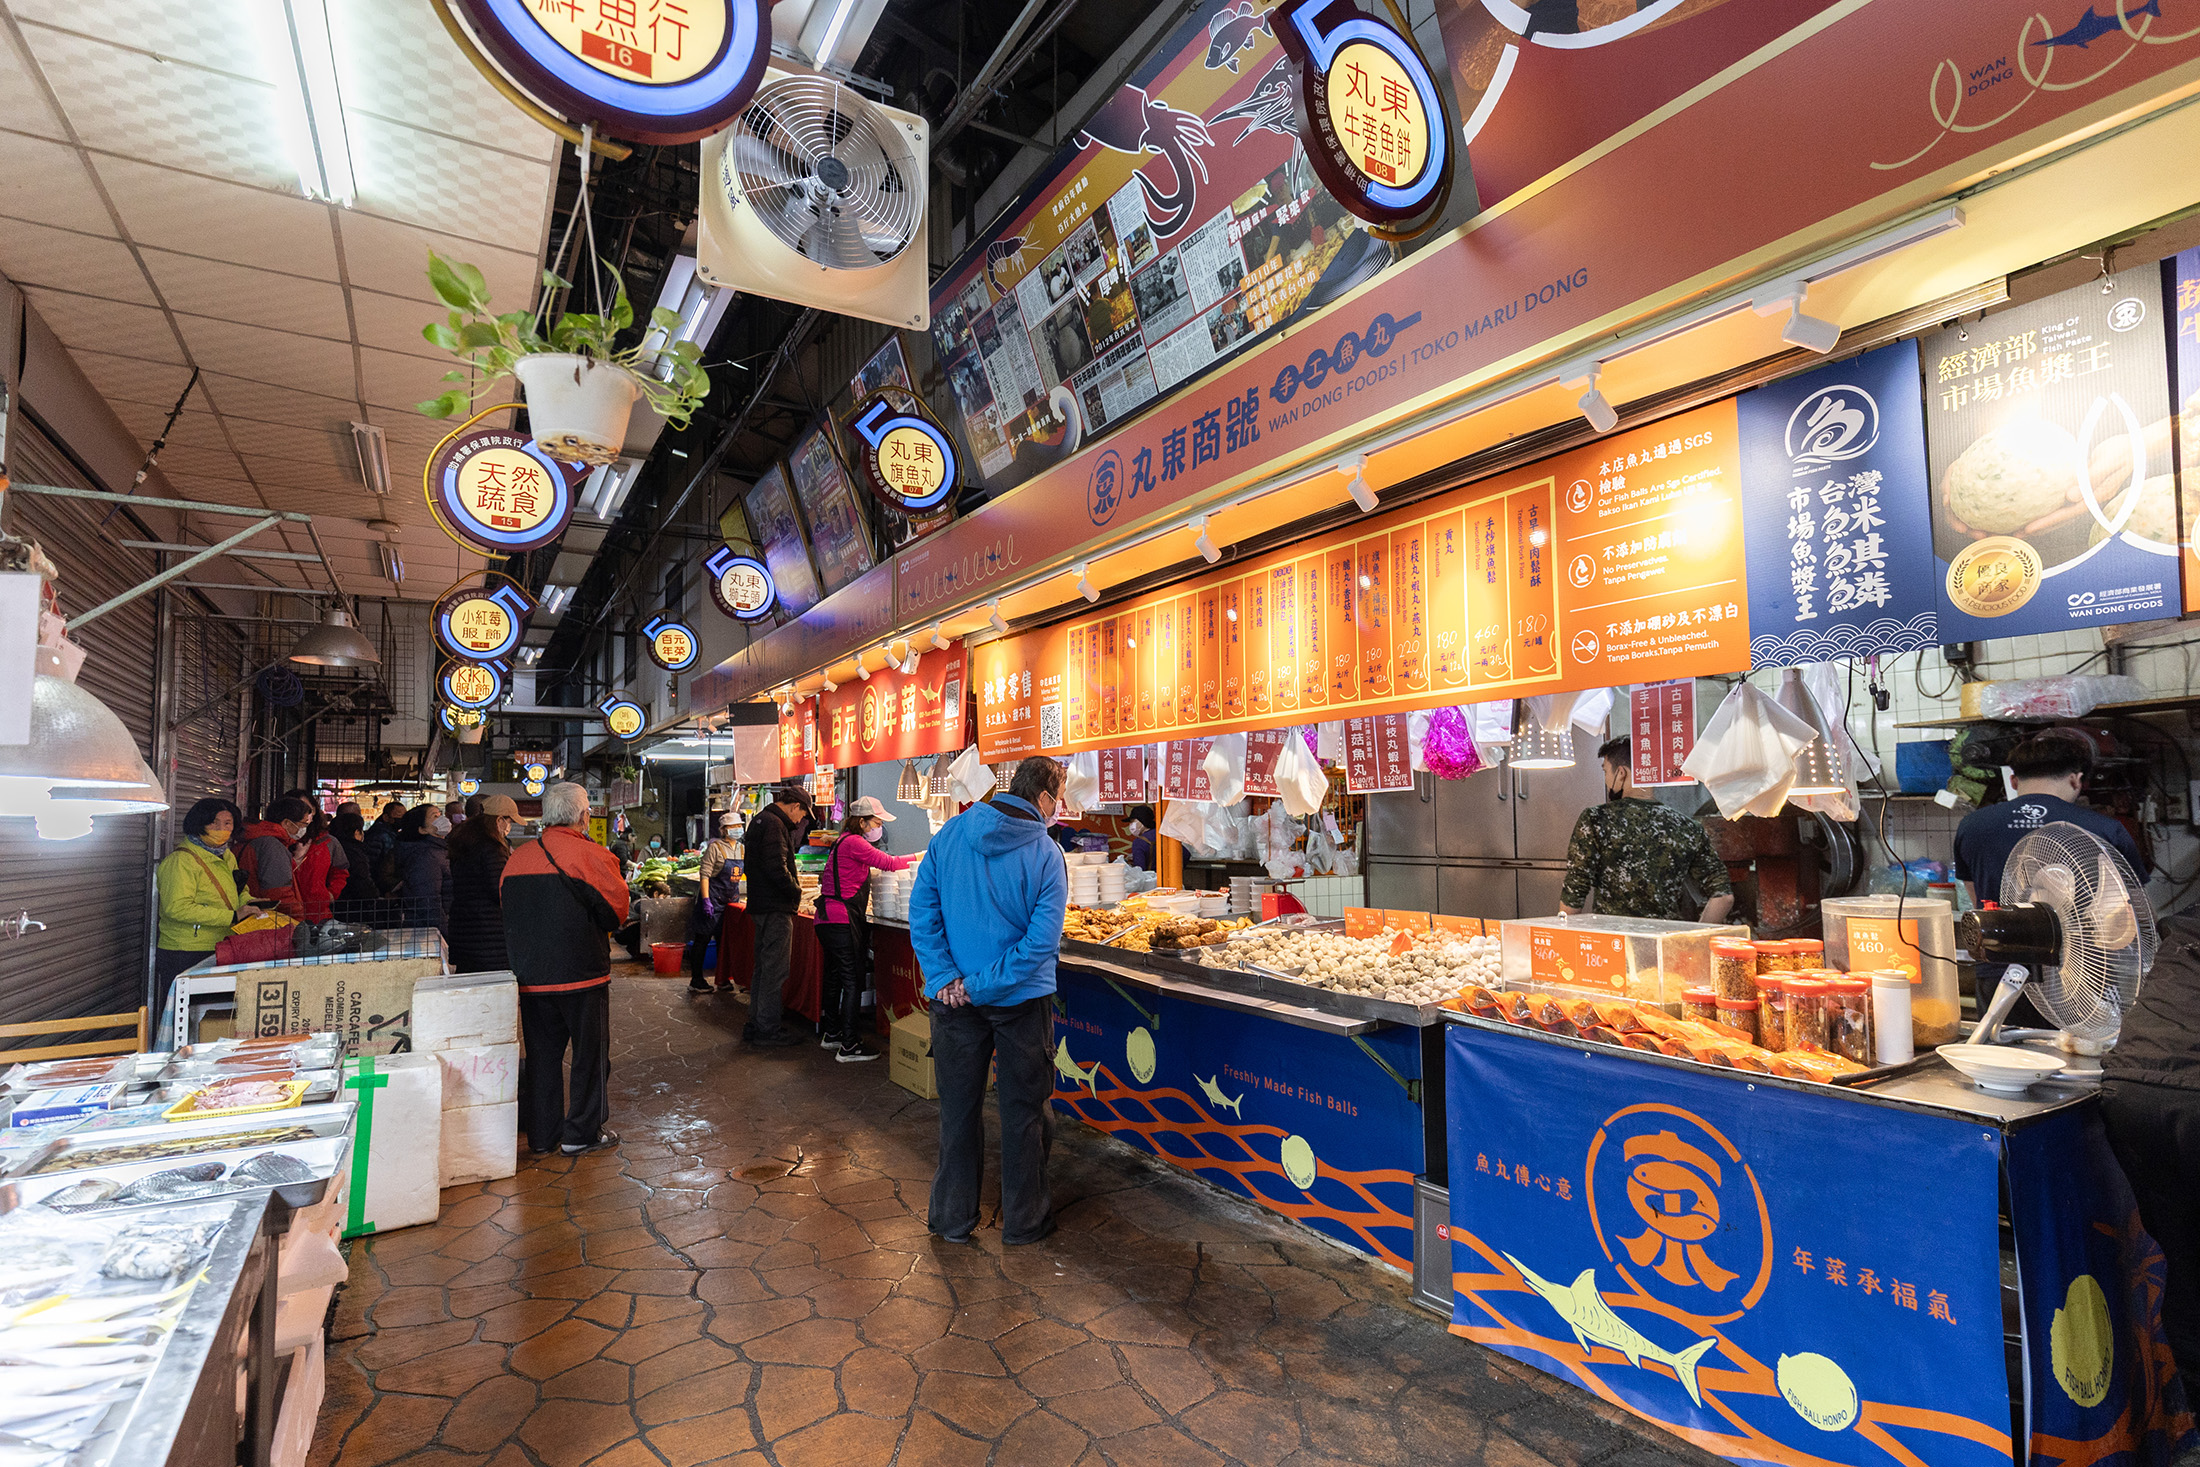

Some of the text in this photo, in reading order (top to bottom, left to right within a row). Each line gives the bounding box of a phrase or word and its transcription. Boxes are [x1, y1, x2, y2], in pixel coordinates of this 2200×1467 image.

[606, 43, 633, 67] 16
[1970, 57, 2007, 81] WAN
[1345, 62, 1411, 124] 丸東
[1968, 68, 2014, 97] DONG
[1344, 106, 1411, 170] 牛蒡魚餅
[1375, 163, 1388, 177] 08
[1244, 258, 1279, 288] 2010年
[2042, 316, 2079, 334] King Of
[2042, 329, 2077, 344] Taiwan
[1268, 267, 1588, 433] WAN DONG FOODS TOKO MARU DONG
[1938, 329, 2037, 384] 經濟部
[2043, 335, 2092, 354] Fish Paste
[1279, 323, 1391, 398] 手工魚丸
[890, 439, 933, 463] 丸東
[1128, 386, 1260, 499] 丸東商號
[478, 461, 539, 493] 天然
[890, 462, 934, 487] 旗魚丸
[1599, 474, 1626, 495] 檢驗
[476, 484, 538, 518] 蔬食
[1598, 496, 1612, 507] Our
[1614, 492, 1629, 502] Fish
[1631, 488, 1648, 498] Balls
[1650, 483, 1665, 493] Are
[1667, 479, 1680, 490] Sgs
[1599, 495, 1659, 518] Bakso Ikan Kami
[501, 517, 513, 526] 15
[1445, 528, 1454, 555] 貢丸
[1528, 504, 1542, 587] 古早肉鬆酥
[1787, 486, 1818, 621] 市場魚漿王
[730, 573, 761, 589] 丸東
[1603, 567, 1614, 575] No
[1604, 566, 1665, 585] Tanpa Pengawet
[1977, 562, 2008, 578] 優良
[728, 588, 761, 605] 獅子頭
[1969, 600, 2009, 612] DELICIOUS
[2009, 586, 2027, 605] FOOD
[1978, 579, 2009, 595] 商家
[462, 609, 501, 626] 小紅莓
[1606, 602, 1738, 637] 不添加硼砂及不漂白
[2069, 599, 2164, 618] WAN DONG FOODS
[462, 627, 501, 640] 服飾
[1474, 625, 1500, 642] 460
[1517, 614, 1547, 636] 180
[662, 635, 685, 644] 百元
[1397, 640, 1420, 658] 220
[1437, 630, 1457, 649] 180
[1480, 643, 1497, 655] 元/斤
[1606, 638, 1648, 652] Borax-Free
[1658, 629, 1709, 644] Unbleached.
[1607, 640, 1719, 663] Tanpa Pemutih
[1306, 660, 1320, 673] 180
[1335, 654, 1350, 667] 180
[1366, 648, 1382, 662] 180
[1403, 658, 1418, 668] 元/斤
[1440, 651, 1456, 661] 元/斤
[459, 669, 486, 684] KiKi
[1252, 671, 1264, 684] 160
[1277, 666, 1291, 679] 180
[456, 682, 490, 696] 服飾
[984, 670, 1032, 707] 批發零售
[832, 683, 917, 748] 百元 年菜
[1671, 688, 1684, 767] 古早味肉鬆
[1639, 691, 1651, 766] 手工旗魚鬆
[1350, 718, 1367, 777] 香菇魚丸
[1385, 715, 1400, 775] 花枝丸蝦丸
[1104, 749, 1115, 792] 大條雞捲
[1126, 749, 1137, 790] 蝦捲
[1170, 741, 1183, 787] 紅燒肉捲
[291, 990, 300, 1020] EXPIRY
[336, 981, 345, 1018] COLOMBIA
[261, 989, 280, 1037] 3 59
[349, 992, 362, 1043] CARCAFE
[1069, 1017, 1103, 1036] Fish Balls
[1224, 1064, 1358, 1117] Freshly Made Fish Balls
[1475, 1152, 1573, 1201] 魚丸傳心意
[1792, 1246, 1958, 1326] 年菜承福氣
[2065, 1366, 2080, 1396] FISH
[2080, 1381, 2094, 1398] BALL
[1787, 1388, 1847, 1426] FISH BALL HONPO
